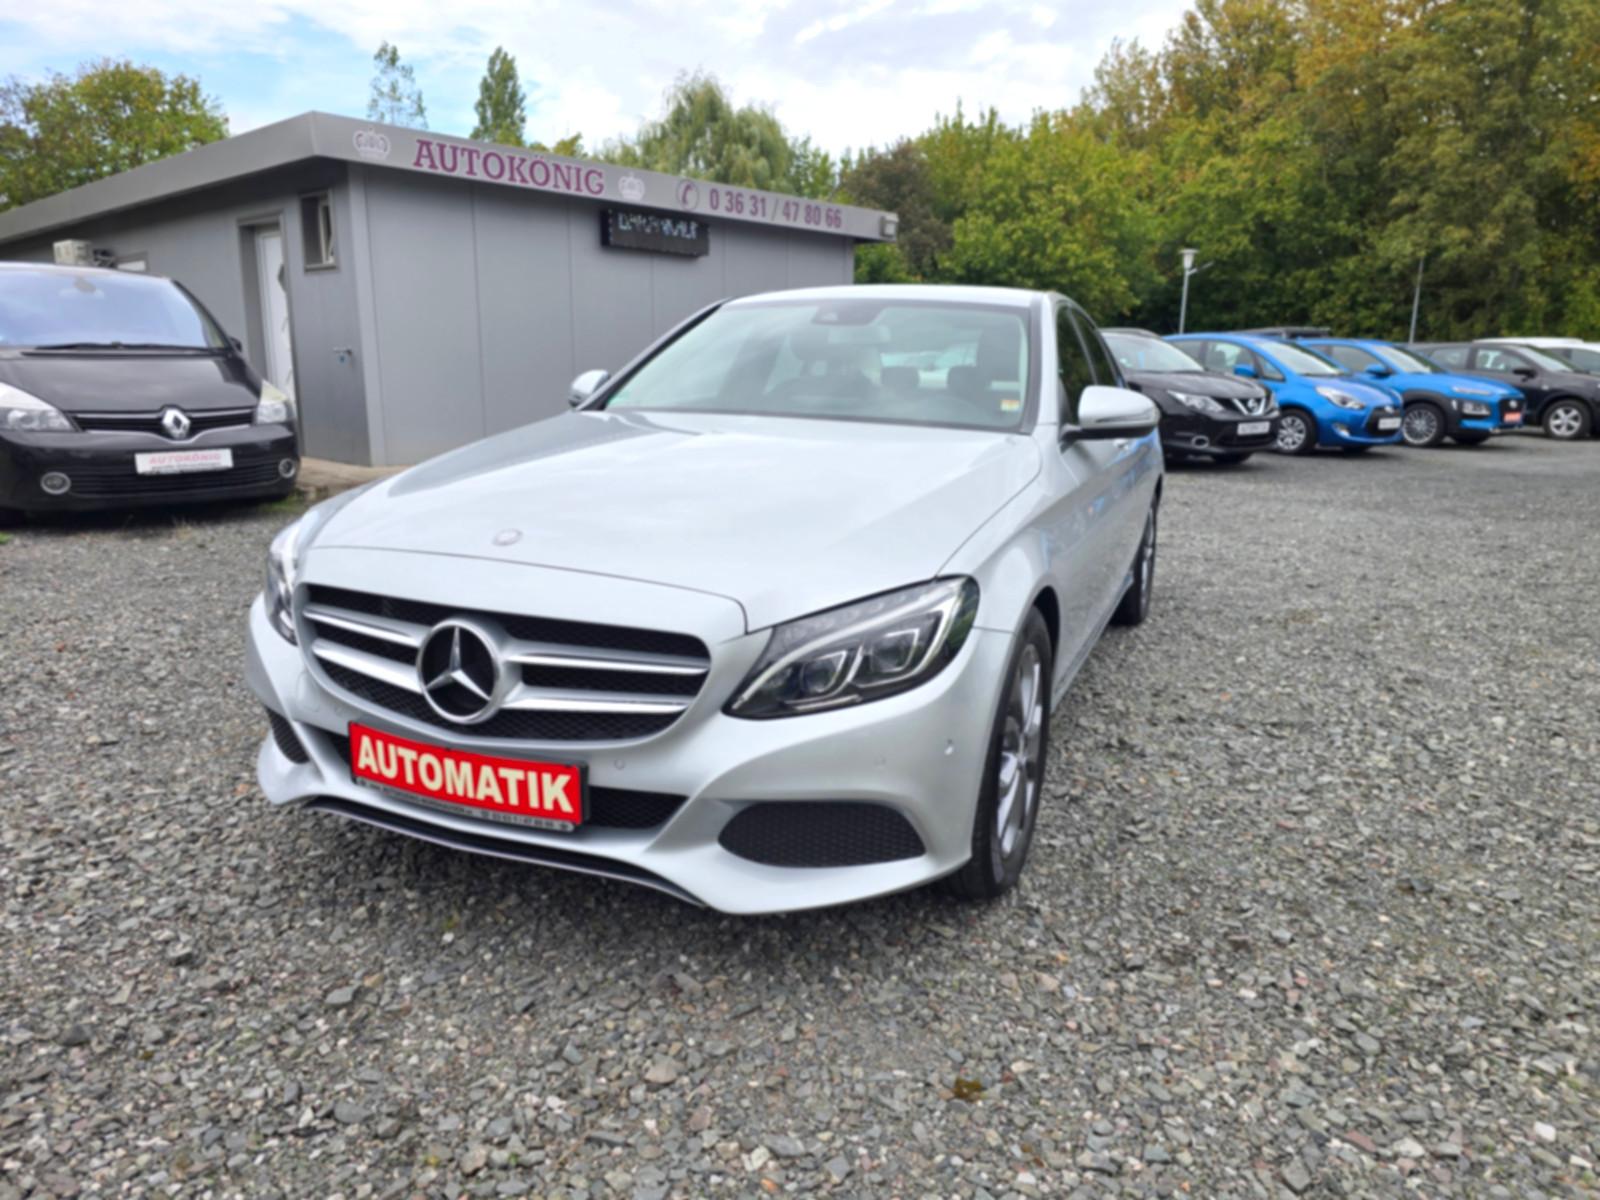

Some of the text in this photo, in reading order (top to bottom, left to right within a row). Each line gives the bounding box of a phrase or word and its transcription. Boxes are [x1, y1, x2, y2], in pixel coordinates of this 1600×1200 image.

[413, 139, 604, 195] AUTOKÖNIG
[709, 188, 719, 210] 0
[725, 190, 744, 214] 36
[749, 194, 766, 217] 31
[782, 201, 799, 222] 47
[804, 204, 821, 225] 80
[825, 207, 842, 228] 66
[357, 735, 574, 813] AUTOMATIK
